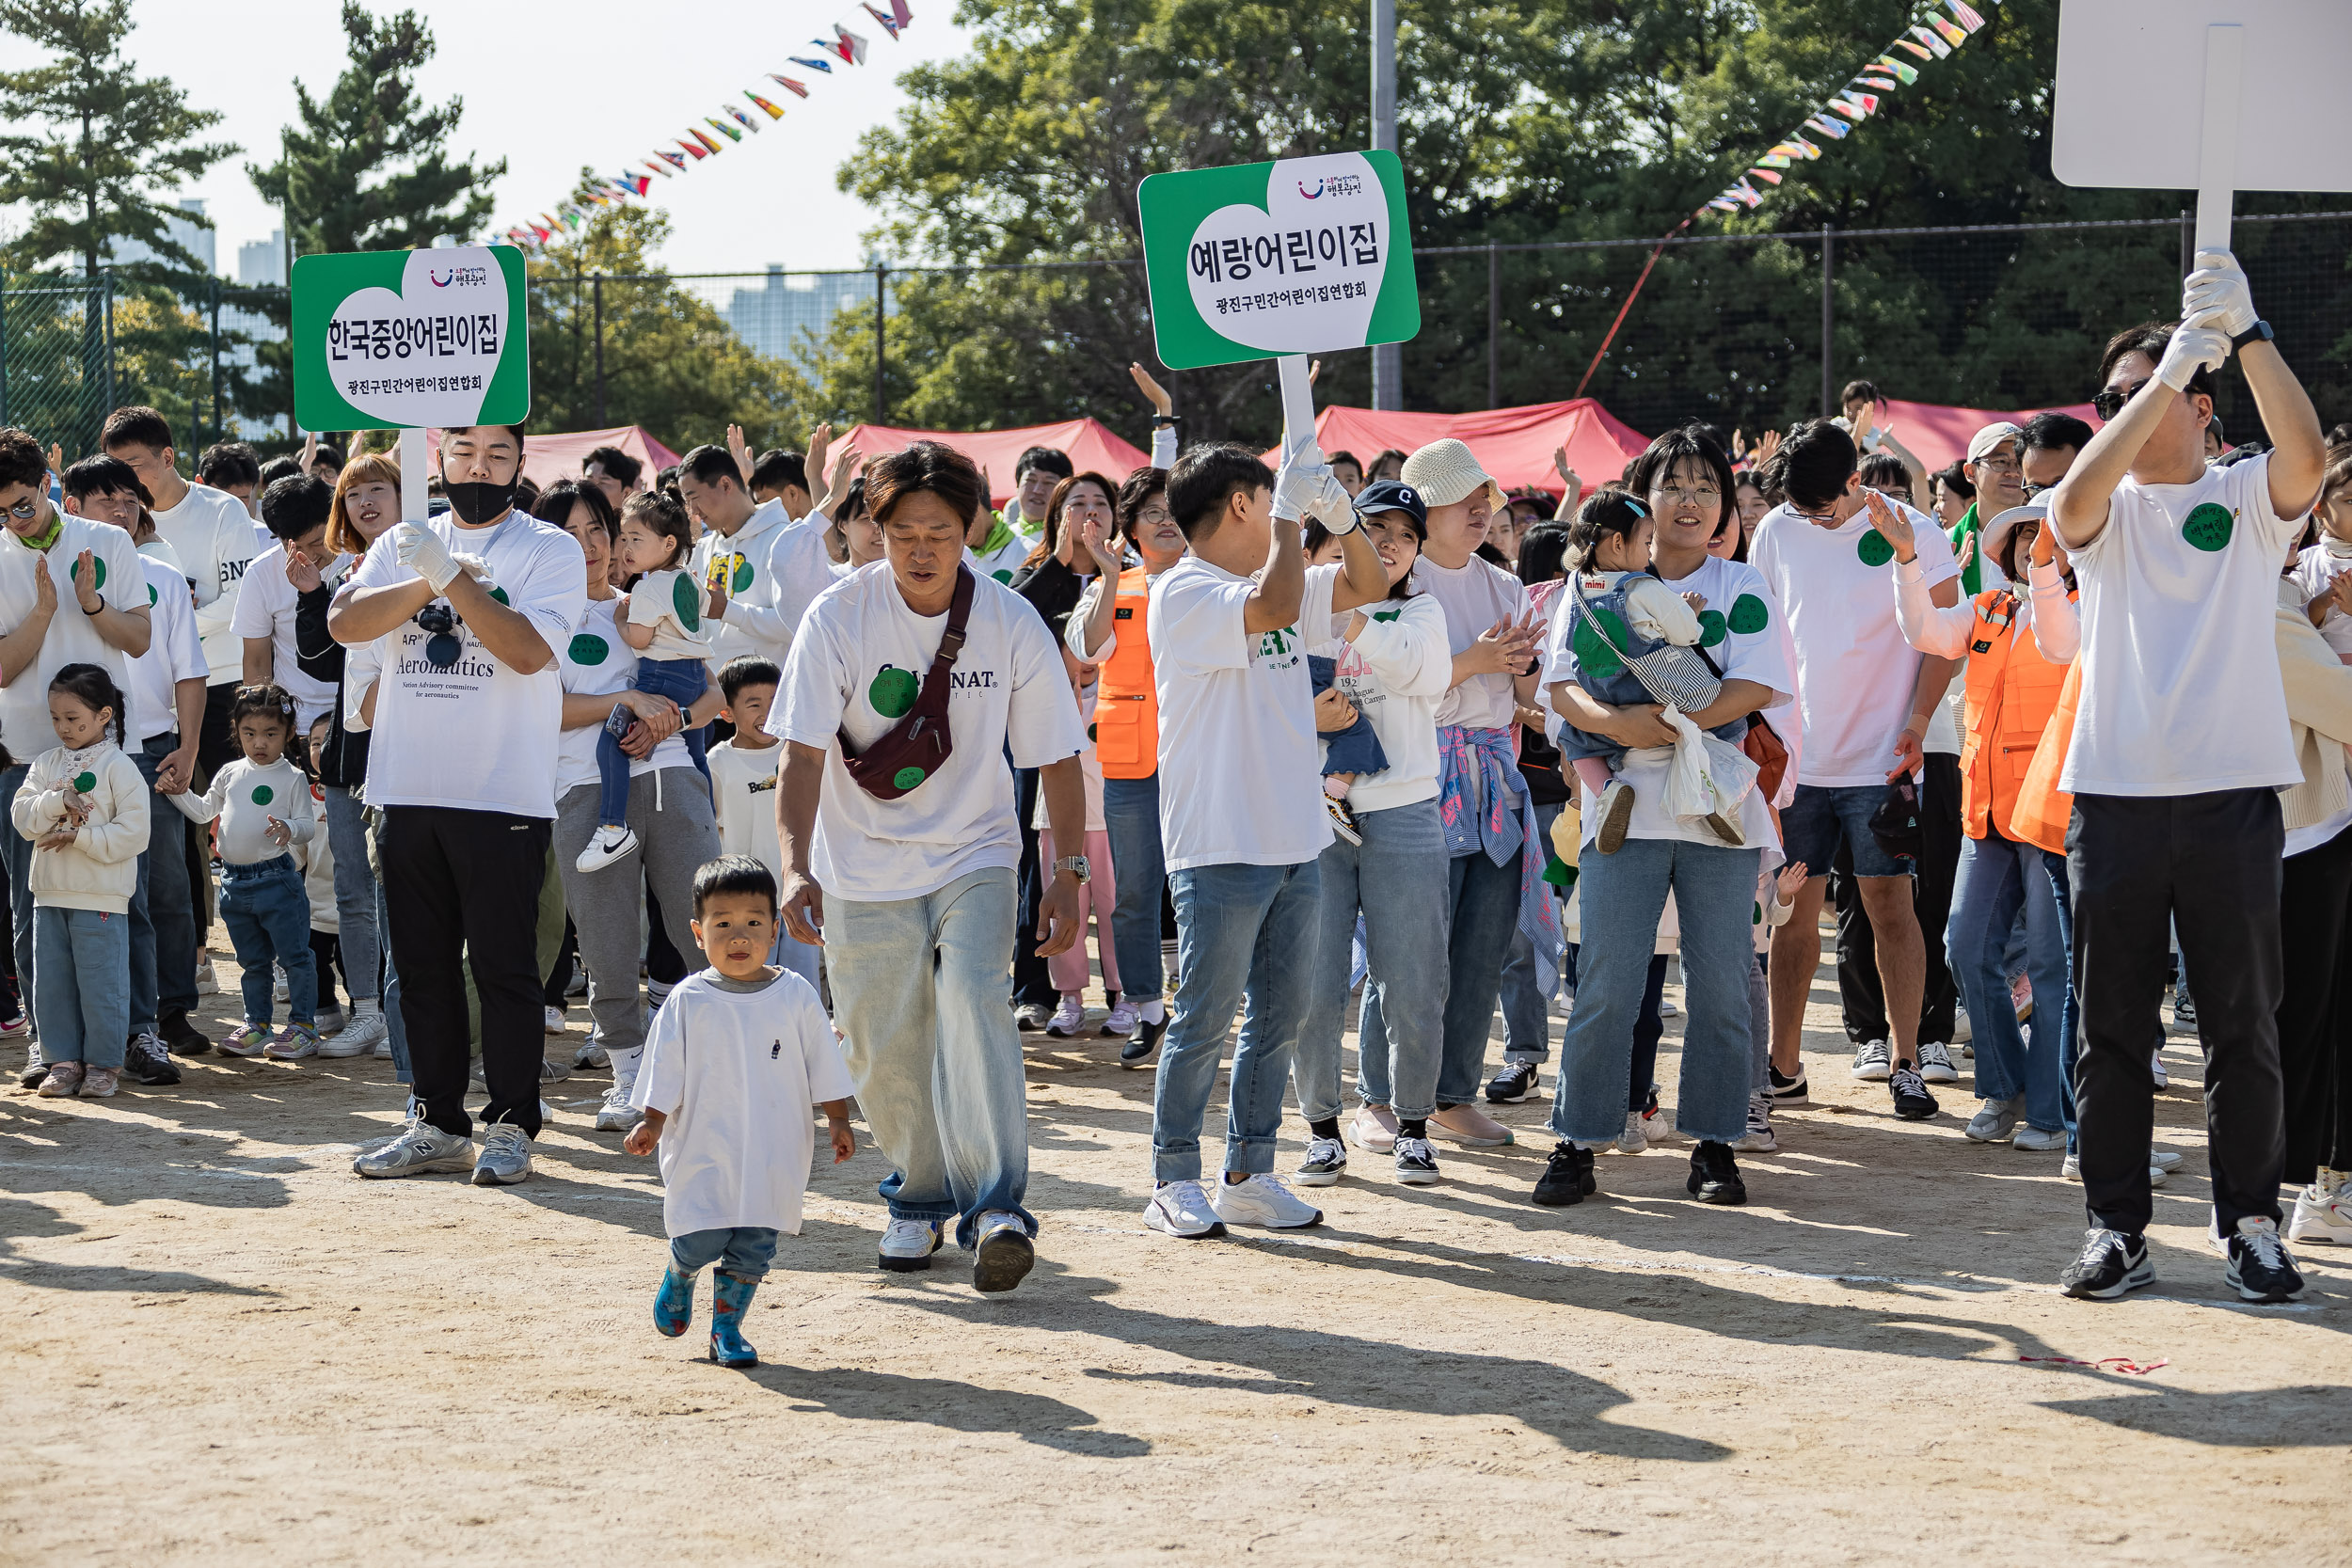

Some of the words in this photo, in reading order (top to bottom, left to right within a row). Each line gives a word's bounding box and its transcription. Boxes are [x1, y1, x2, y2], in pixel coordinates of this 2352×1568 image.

[1327, 182, 1361, 197] 행복광진
[1191, 222, 1378, 283] 예랑어린이집
[455, 274, 486, 286] 행복광진
[1216, 281, 1367, 314] 광진구민간어린이집연합회
[329, 313, 498, 360] 한국중앙어린이집
[348, 375, 482, 395] 광진구민간어린이집연합회
[1399, 488, 1412, 504] C
[1584, 579, 1606, 589] mimi
[419, 681, 444, 690] Advisory
[413, 1139, 436, 1157] N
